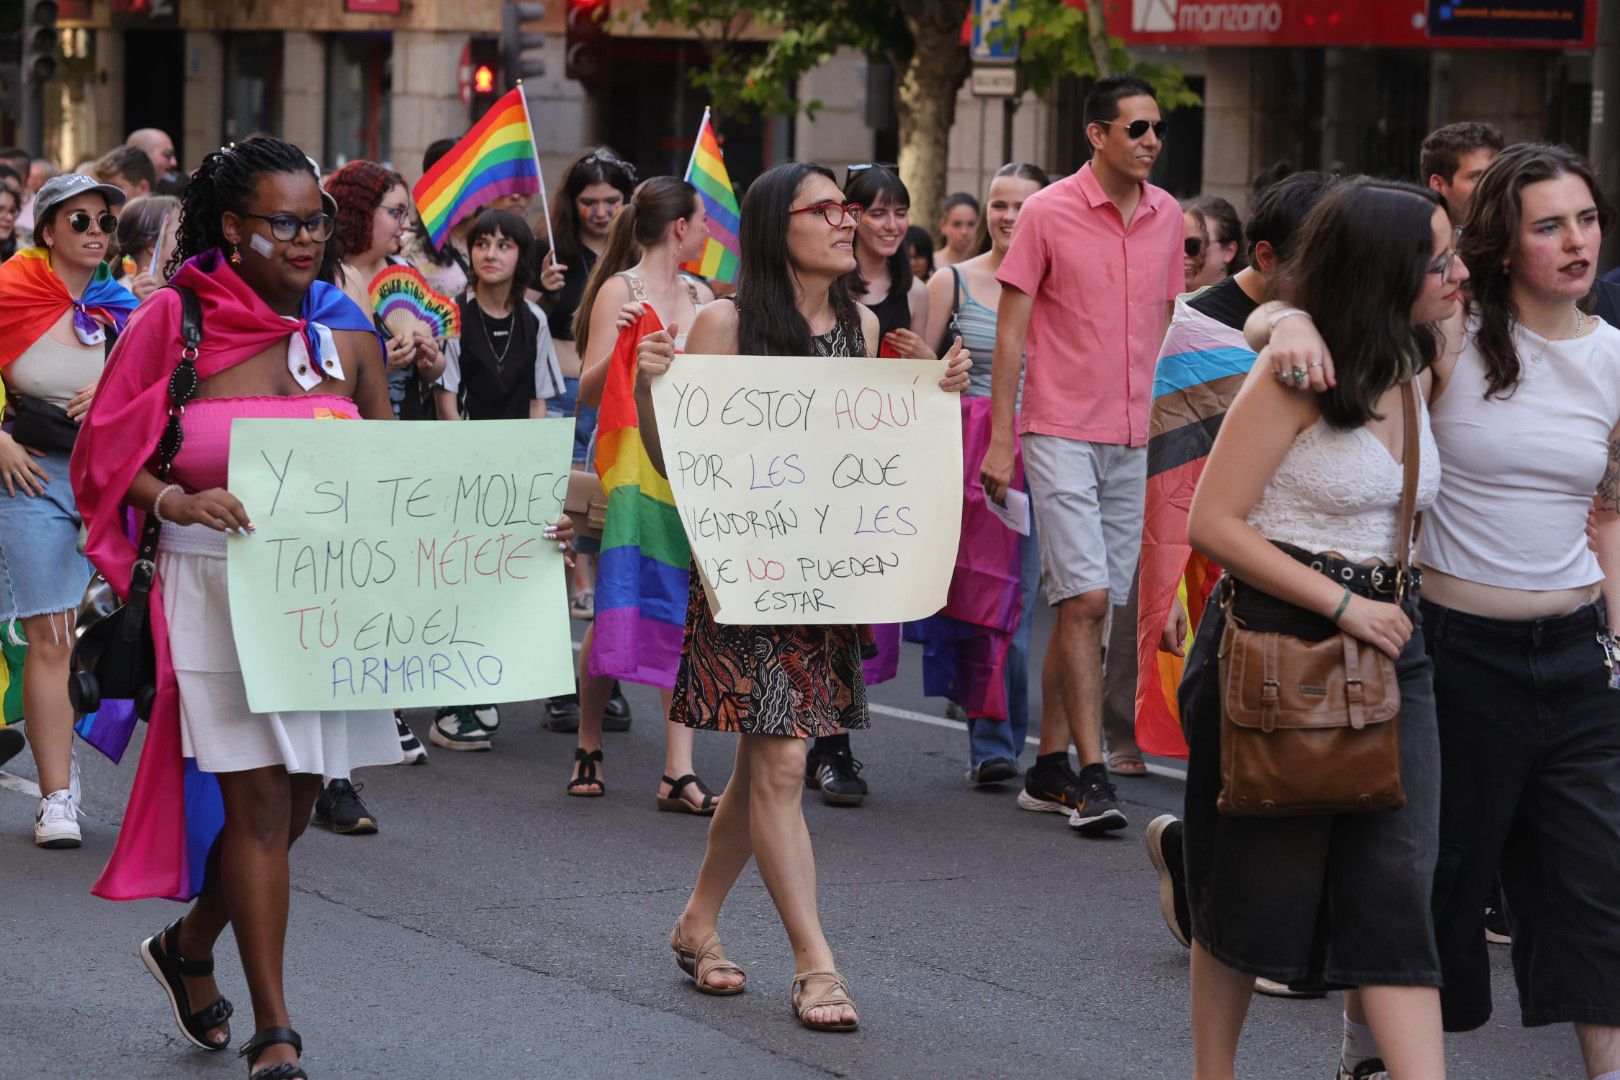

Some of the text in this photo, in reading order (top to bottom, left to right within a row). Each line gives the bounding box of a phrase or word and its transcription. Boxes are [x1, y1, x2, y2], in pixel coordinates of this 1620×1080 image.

[1179, 3, 1283, 32] manzano
[378, 279, 402, 300] NEVER
[403, 280, 425, 303] STOP
[672, 375, 920, 431] YO ESTOY AQUÍ
[261, 449, 568, 527] Y SI TE MOLES
[678, 451, 907, 491] POR LES QUE
[684, 500, 918, 542] VENDRÁN Y LES
[266, 529, 536, 595] TAMOS MÉTETE
[704, 553, 899, 590] UE NO PUEDEN
[754, 588, 836, 614] ESTAR
[285, 598, 484, 650] TÚ EN EL
[332, 650, 503, 698] ARMARIO
